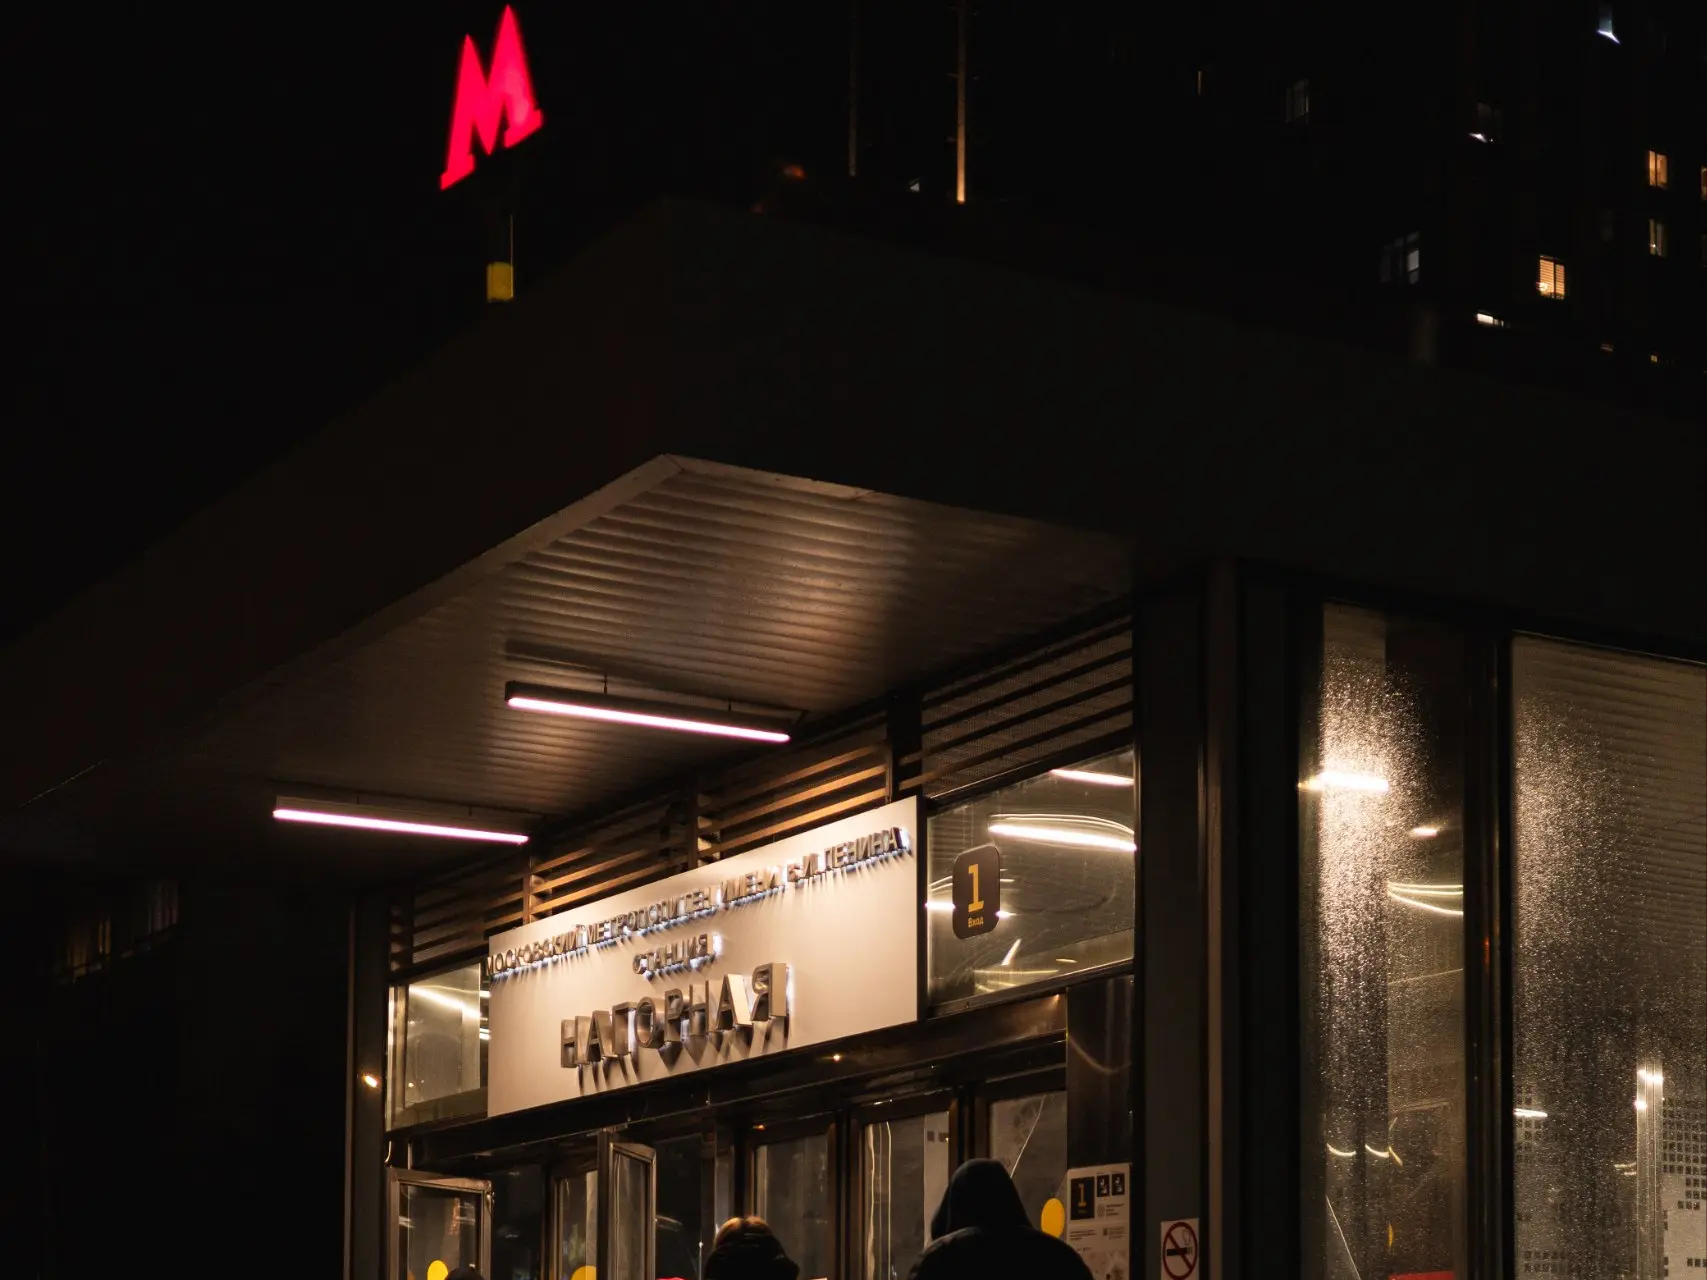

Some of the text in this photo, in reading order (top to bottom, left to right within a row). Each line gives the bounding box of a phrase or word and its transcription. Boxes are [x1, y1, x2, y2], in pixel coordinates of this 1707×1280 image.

[440, 4, 543, 190] М
[486, 924, 586, 976] МОСКОВСКИЙ
[587, 886, 718, 944] МЕТРОПОЛИТЕН
[720, 864, 784, 903] ИМЕНИ
[968, 864, 984, 912] 1
[632, 933, 717, 974] СТАНЦИЯ
[560, 962, 788, 1068] НАГОРНАЯ
